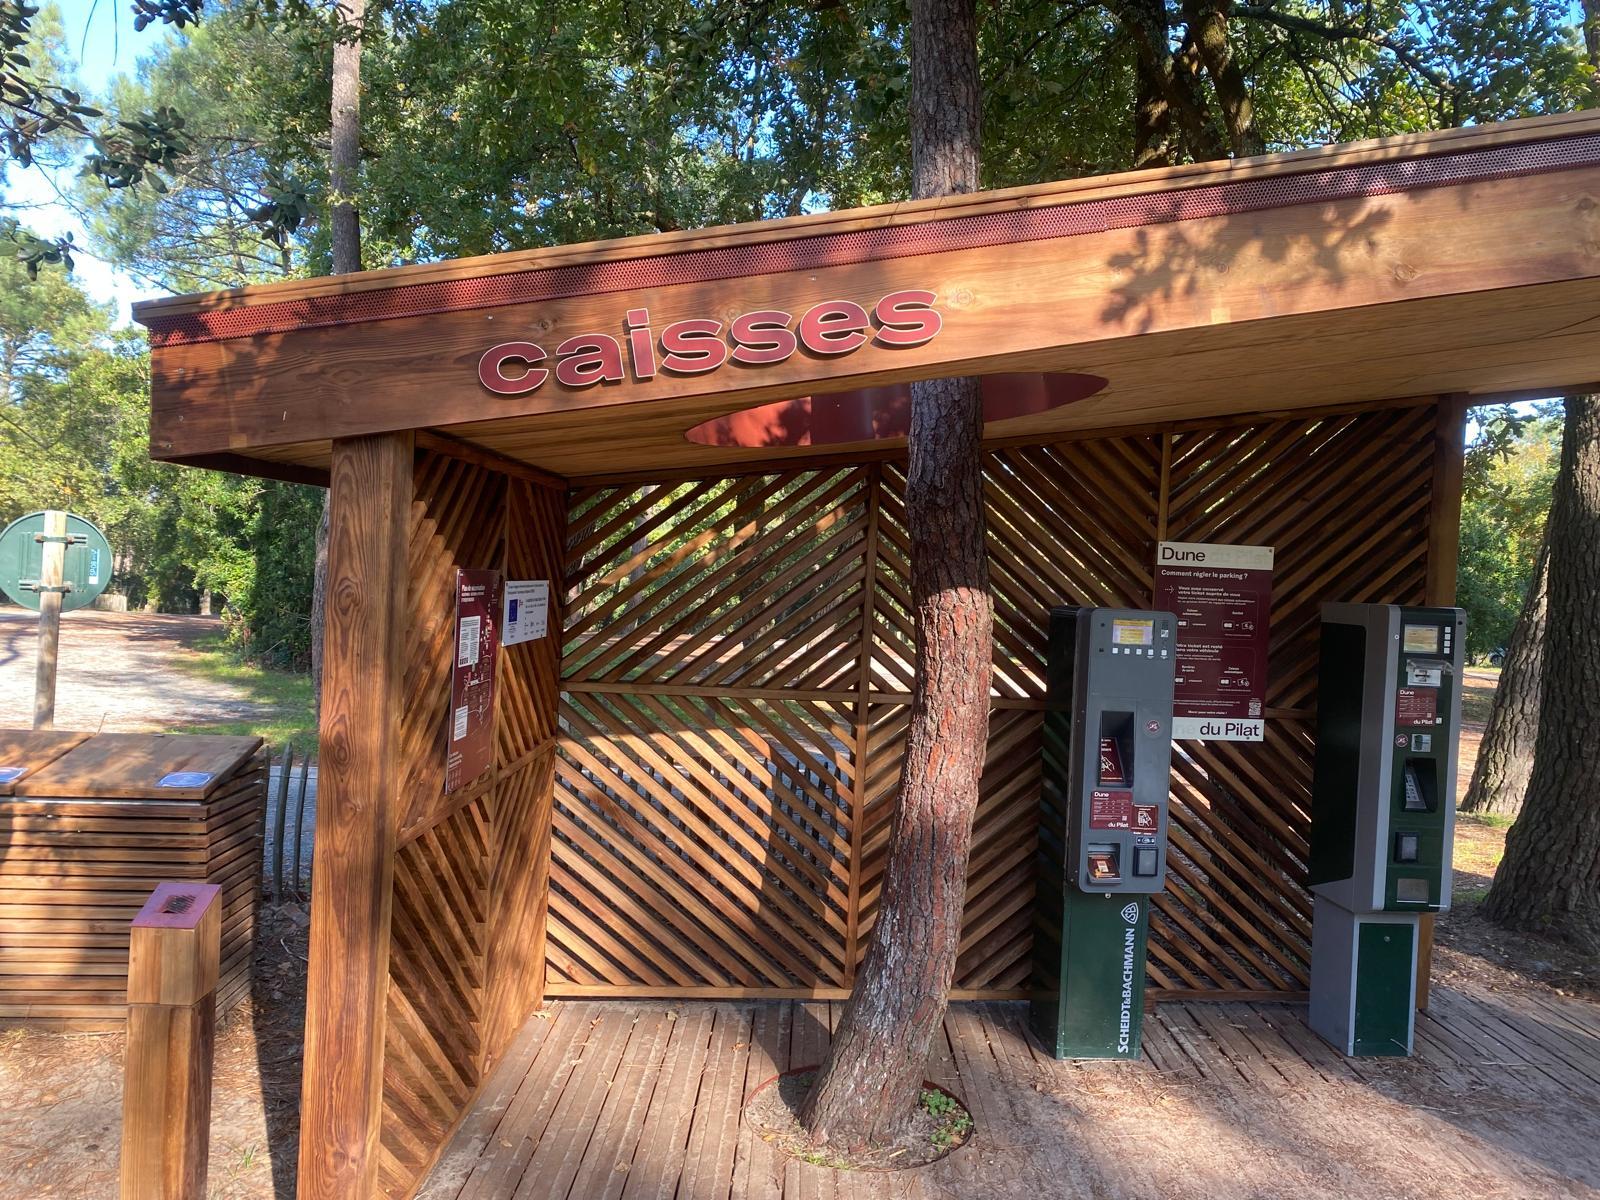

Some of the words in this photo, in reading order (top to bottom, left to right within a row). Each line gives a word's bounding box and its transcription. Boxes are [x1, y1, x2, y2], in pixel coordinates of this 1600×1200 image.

[477, 289, 943, 394] caisses
[1162, 547, 1206, 561] Dune
[1161, 569, 1192, 577] Comment
[1193, 571, 1211, 579] régler
[1219, 572, 1243, 580] parking
[1200, 722, 1220, 735] du
[1225, 722, 1260, 736] Pilat
